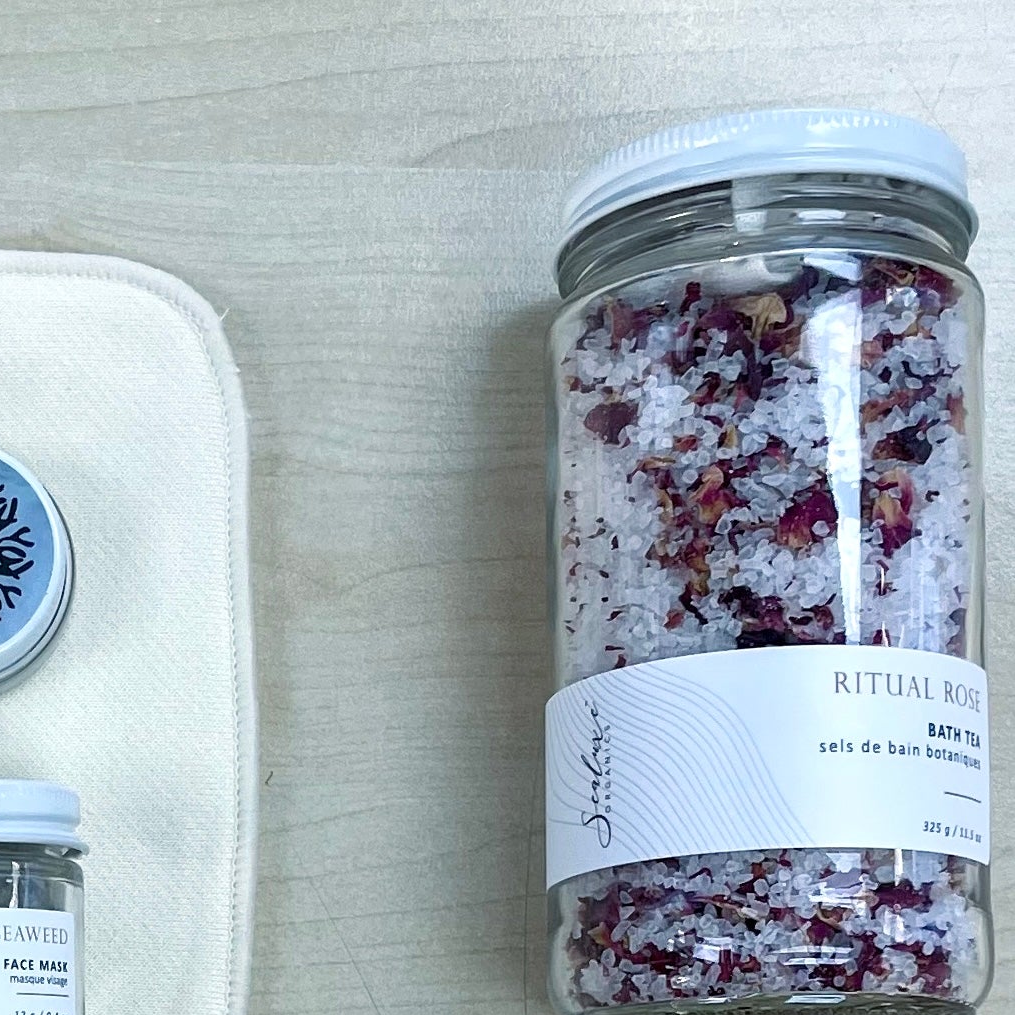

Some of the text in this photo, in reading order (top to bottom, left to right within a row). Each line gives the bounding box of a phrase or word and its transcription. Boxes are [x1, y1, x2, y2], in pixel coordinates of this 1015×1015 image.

[834, 672, 980, 712] RITUAL ROSE
[928, 722, 981, 749] BATH TEA
[820, 739, 853, 752] sels
[862, 740, 881, 753] de
[889, 741, 920, 756] bain
[923, 821, 941, 833] 325
[944, 826, 951, 837] g
[951, 825, 958, 838] /
[4, 959, 68, 972] FACE MASK
[10, 975, 67, 987] masque visage
